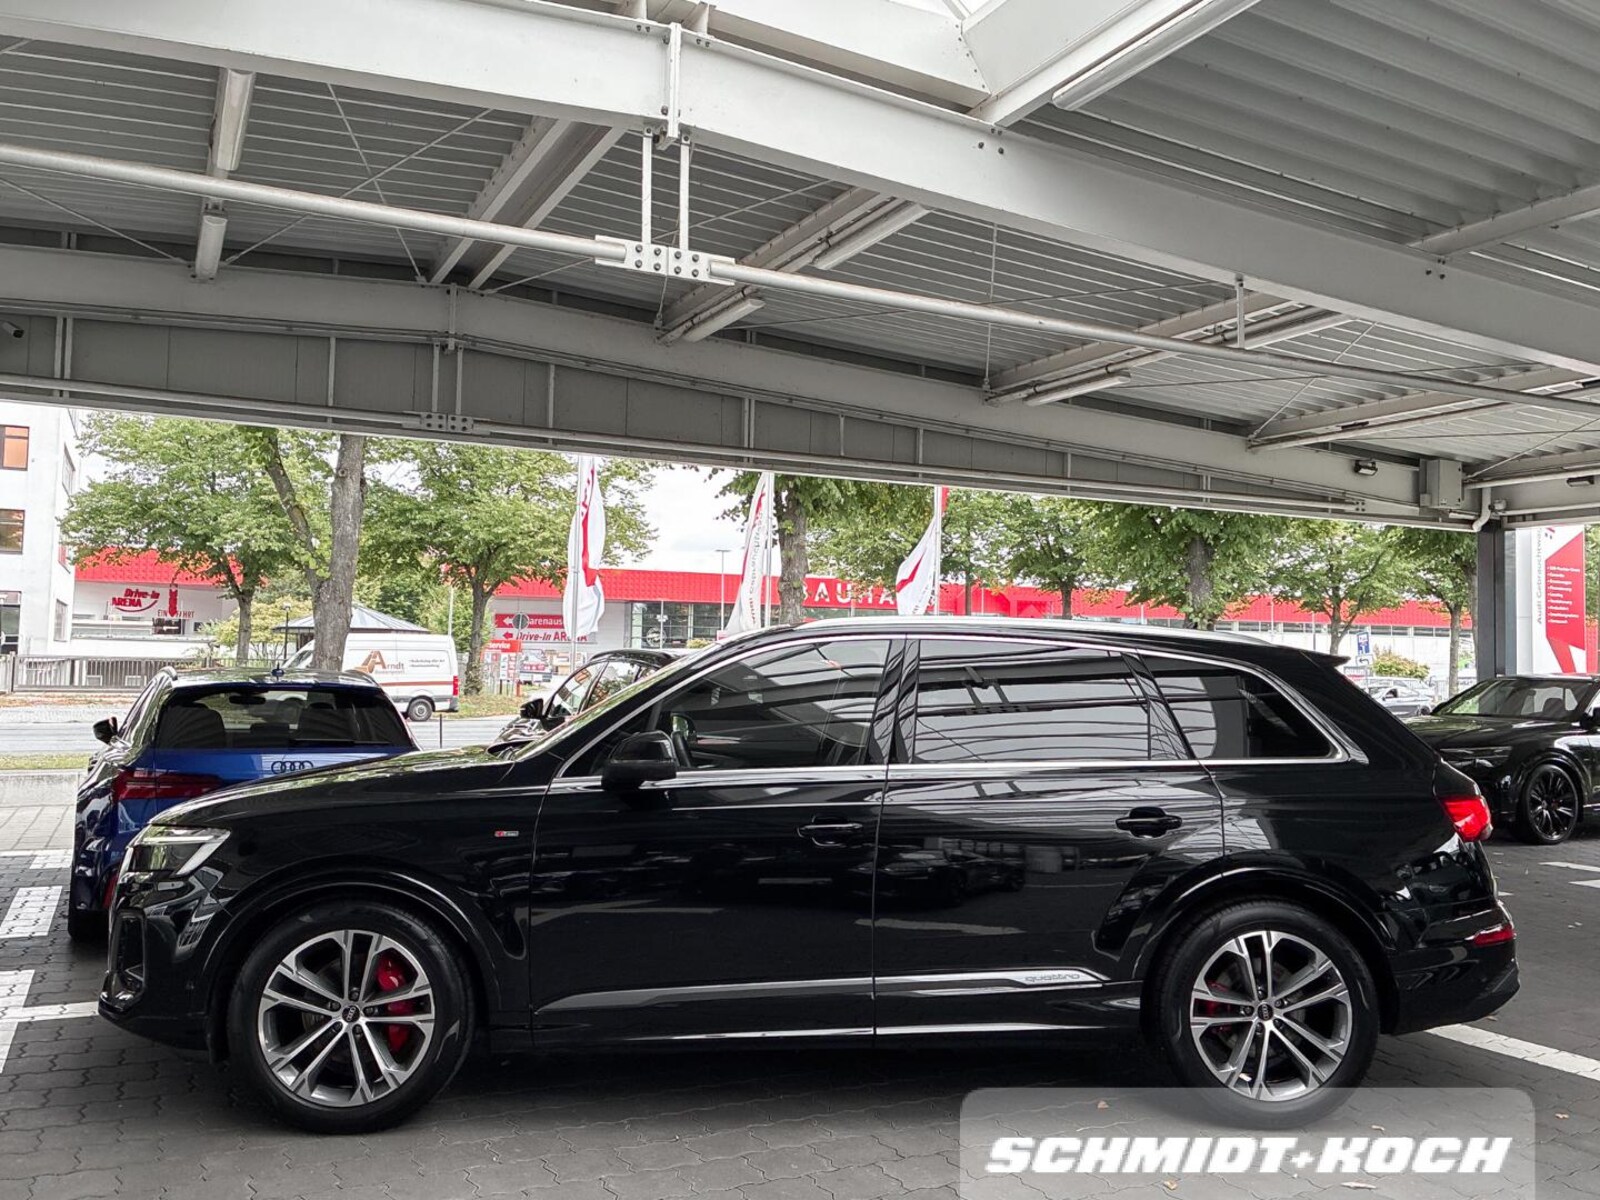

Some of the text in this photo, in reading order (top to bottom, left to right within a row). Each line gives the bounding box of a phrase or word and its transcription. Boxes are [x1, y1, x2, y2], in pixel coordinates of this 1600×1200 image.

[801, 580, 895, 604] BAUHA
[112, 597, 142, 607] ARENA
[553, 631, 588, 641] ARA
[361, 650, 405, 669] Arndt
[1025, 973, 1081, 982] quattro
